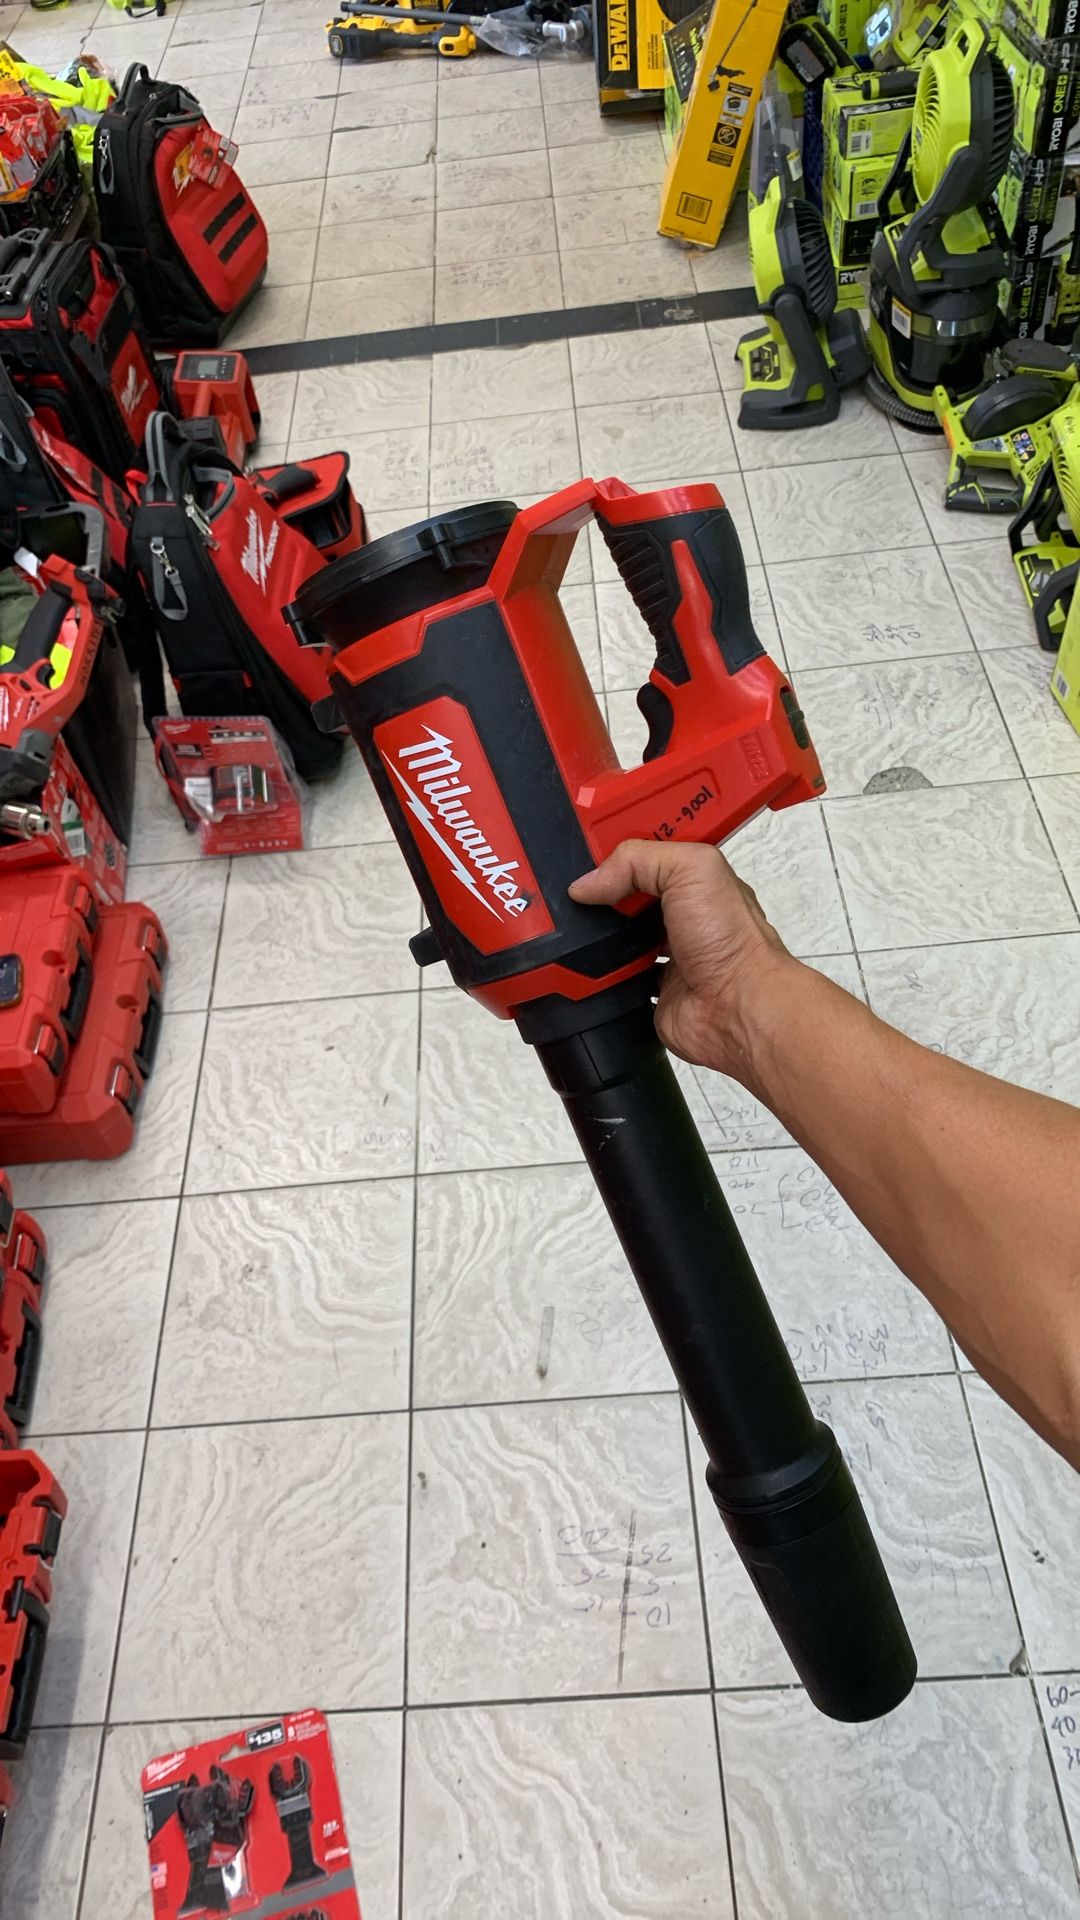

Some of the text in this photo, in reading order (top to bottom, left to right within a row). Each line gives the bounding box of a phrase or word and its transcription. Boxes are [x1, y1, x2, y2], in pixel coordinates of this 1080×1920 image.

[1048, 117, 1064, 152] RYOBI
[1025, 225, 1039, 256] RYOBI
[840, 272, 859, 284] RY
[398, 723, 529, 917] Milwaukee
[734, 1203, 767, 1215] 70
[646, 1602, 671, 1628] 10
[1051, 1716, 1076, 1738] 40
